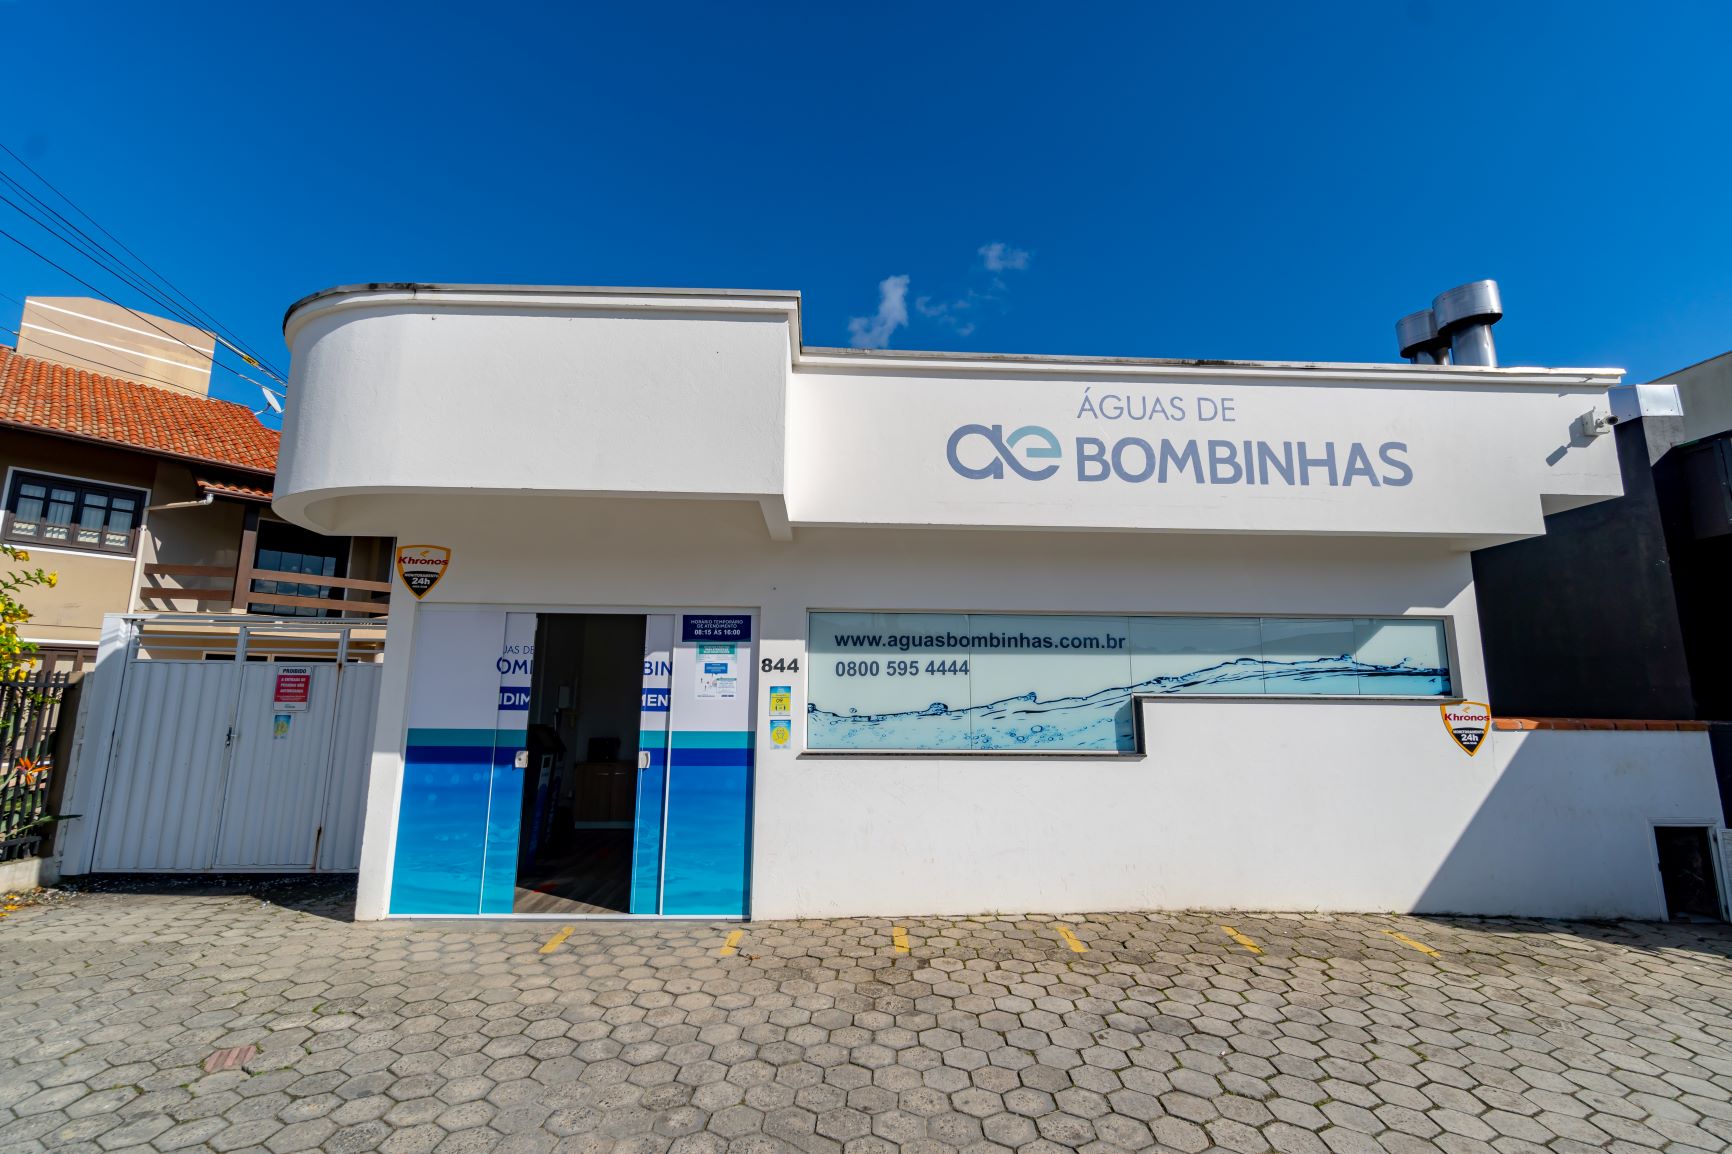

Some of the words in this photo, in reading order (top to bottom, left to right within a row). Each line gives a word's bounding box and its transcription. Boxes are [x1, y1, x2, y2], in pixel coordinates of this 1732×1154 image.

[1076, 387, 1186, 421] ÁGUAS
[1197, 397, 1236, 422] DE
[1075, 437, 1414, 487] BOMBINHAS
[398, 557, 449, 565] Khronos
[834, 632, 1126, 652] www.aguasbombinhas.com.br
[761, 658, 799, 673] 844
[835, 660, 880, 677] 0800
[886, 660, 919, 676] 595
[925, 659, 970, 676] 4444
